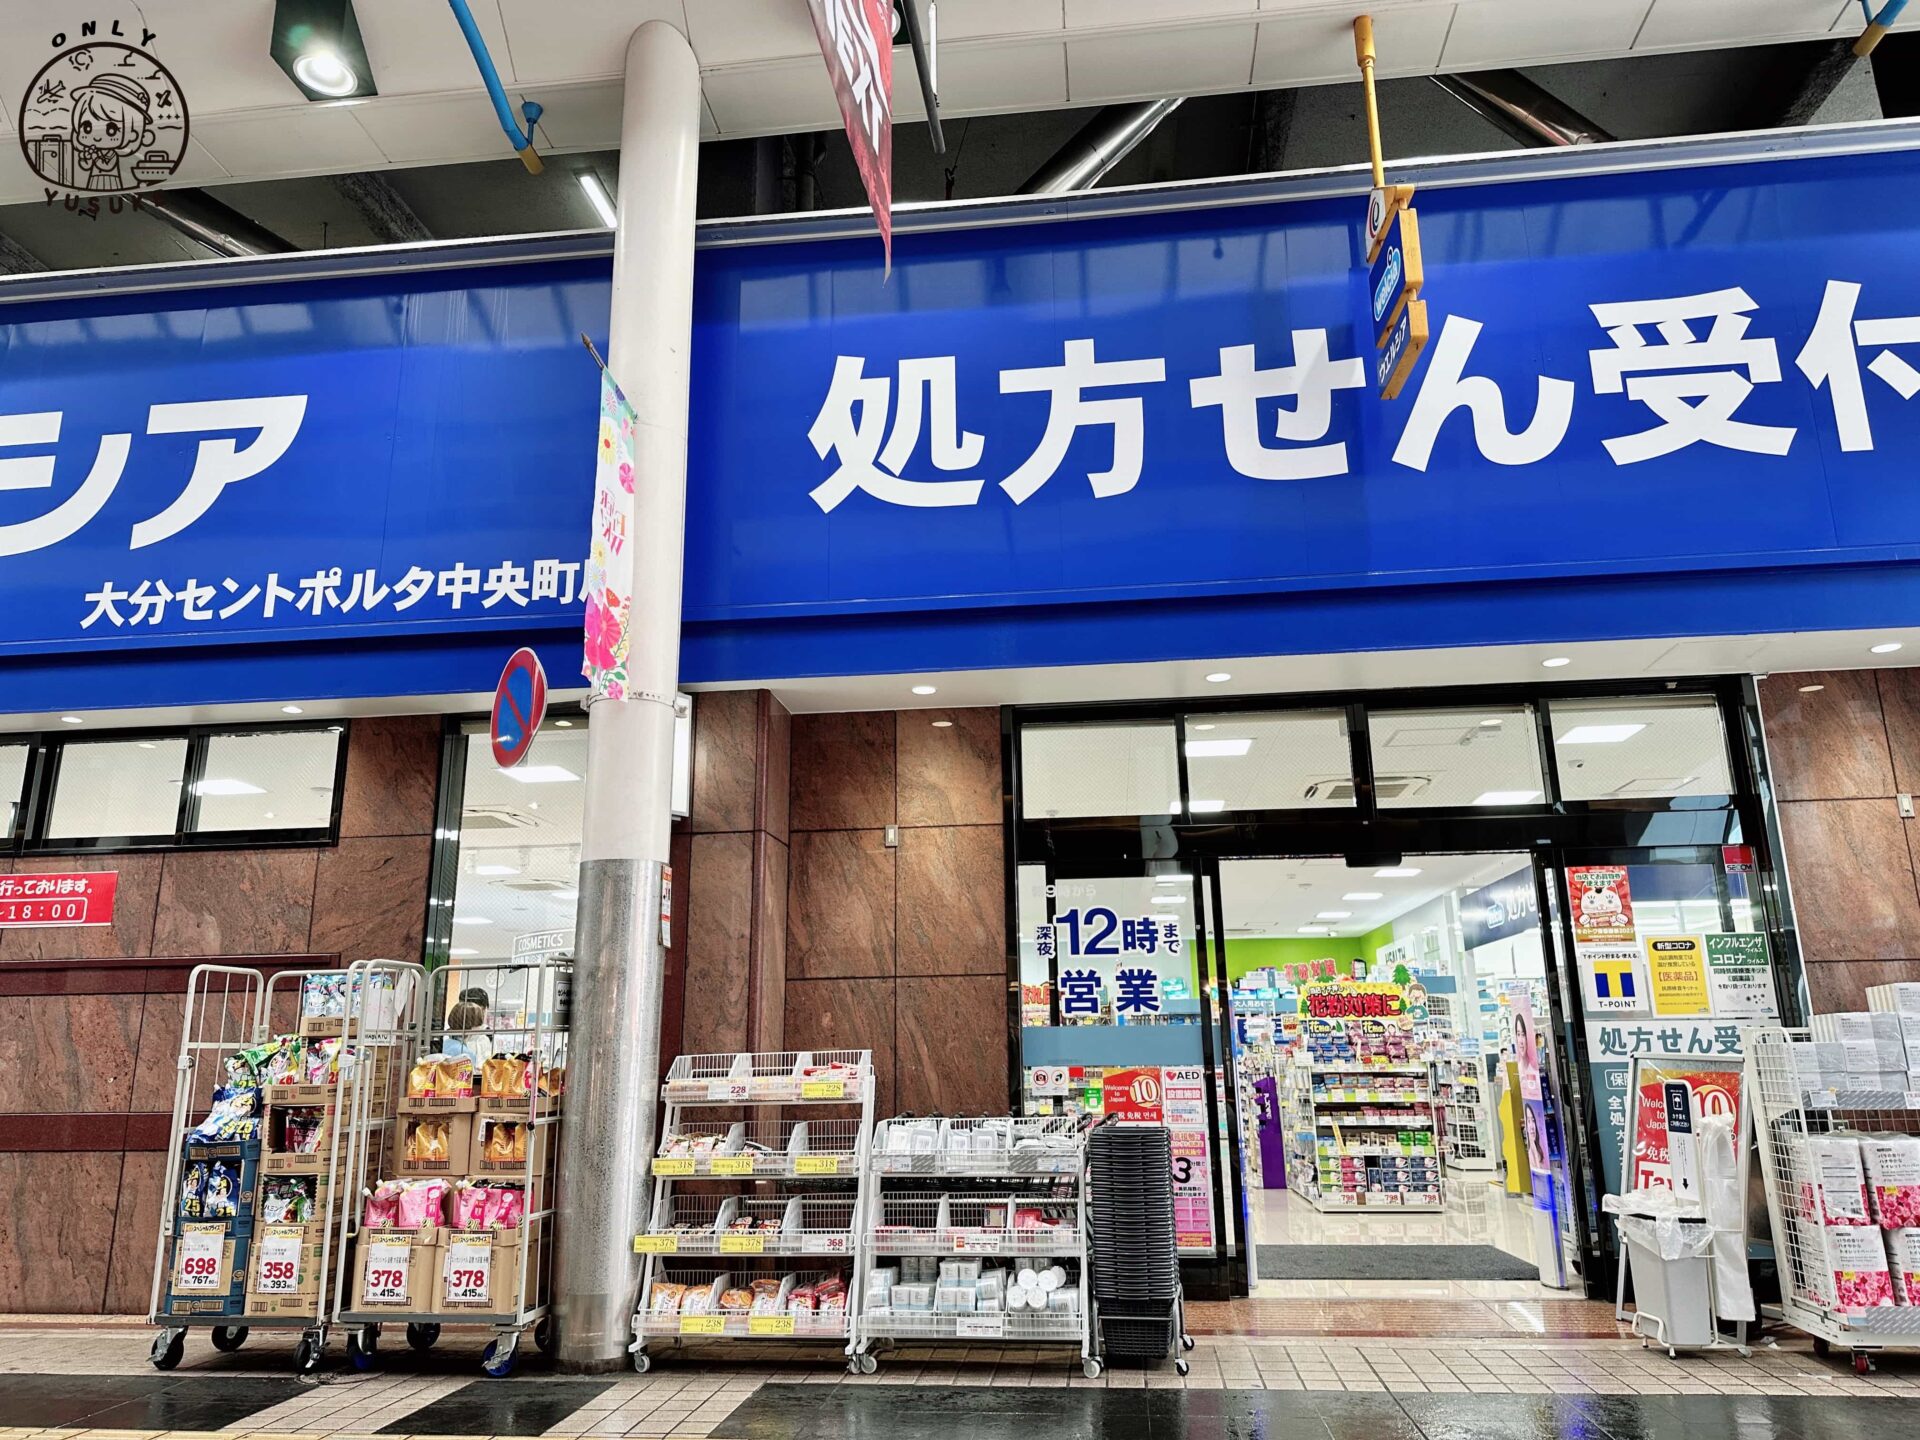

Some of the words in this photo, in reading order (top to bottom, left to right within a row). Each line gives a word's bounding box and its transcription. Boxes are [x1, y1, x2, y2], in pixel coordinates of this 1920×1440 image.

[80, 558, 594, 630] 大分セントポルタ中央町
[518, 933, 564, 951] COSMETICS
[1709, 937, 1762, 949] インフルエンザ
[1713, 954, 1746, 964] コロナ
[1061, 970, 1159, 1013] 営業
[1307, 993, 1401, 1018] 花粉対策に
[1177, 1071, 1199, 1080] AED
[677, 1161, 692, 1169] 318
[735, 1161, 750, 1169] 318
[660, 1239, 675, 1247] 378
[745, 1239, 760, 1247] 378
[827, 1239, 843, 1247] 368
[184, 1258, 216, 1275] 698
[263, 1262, 294, 1279] 358
[370, 1270, 403, 1287] 378
[452, 1270, 484, 1287] 378
[705, 1320, 721, 1328] 238
[775, 1320, 791, 1328] 238
